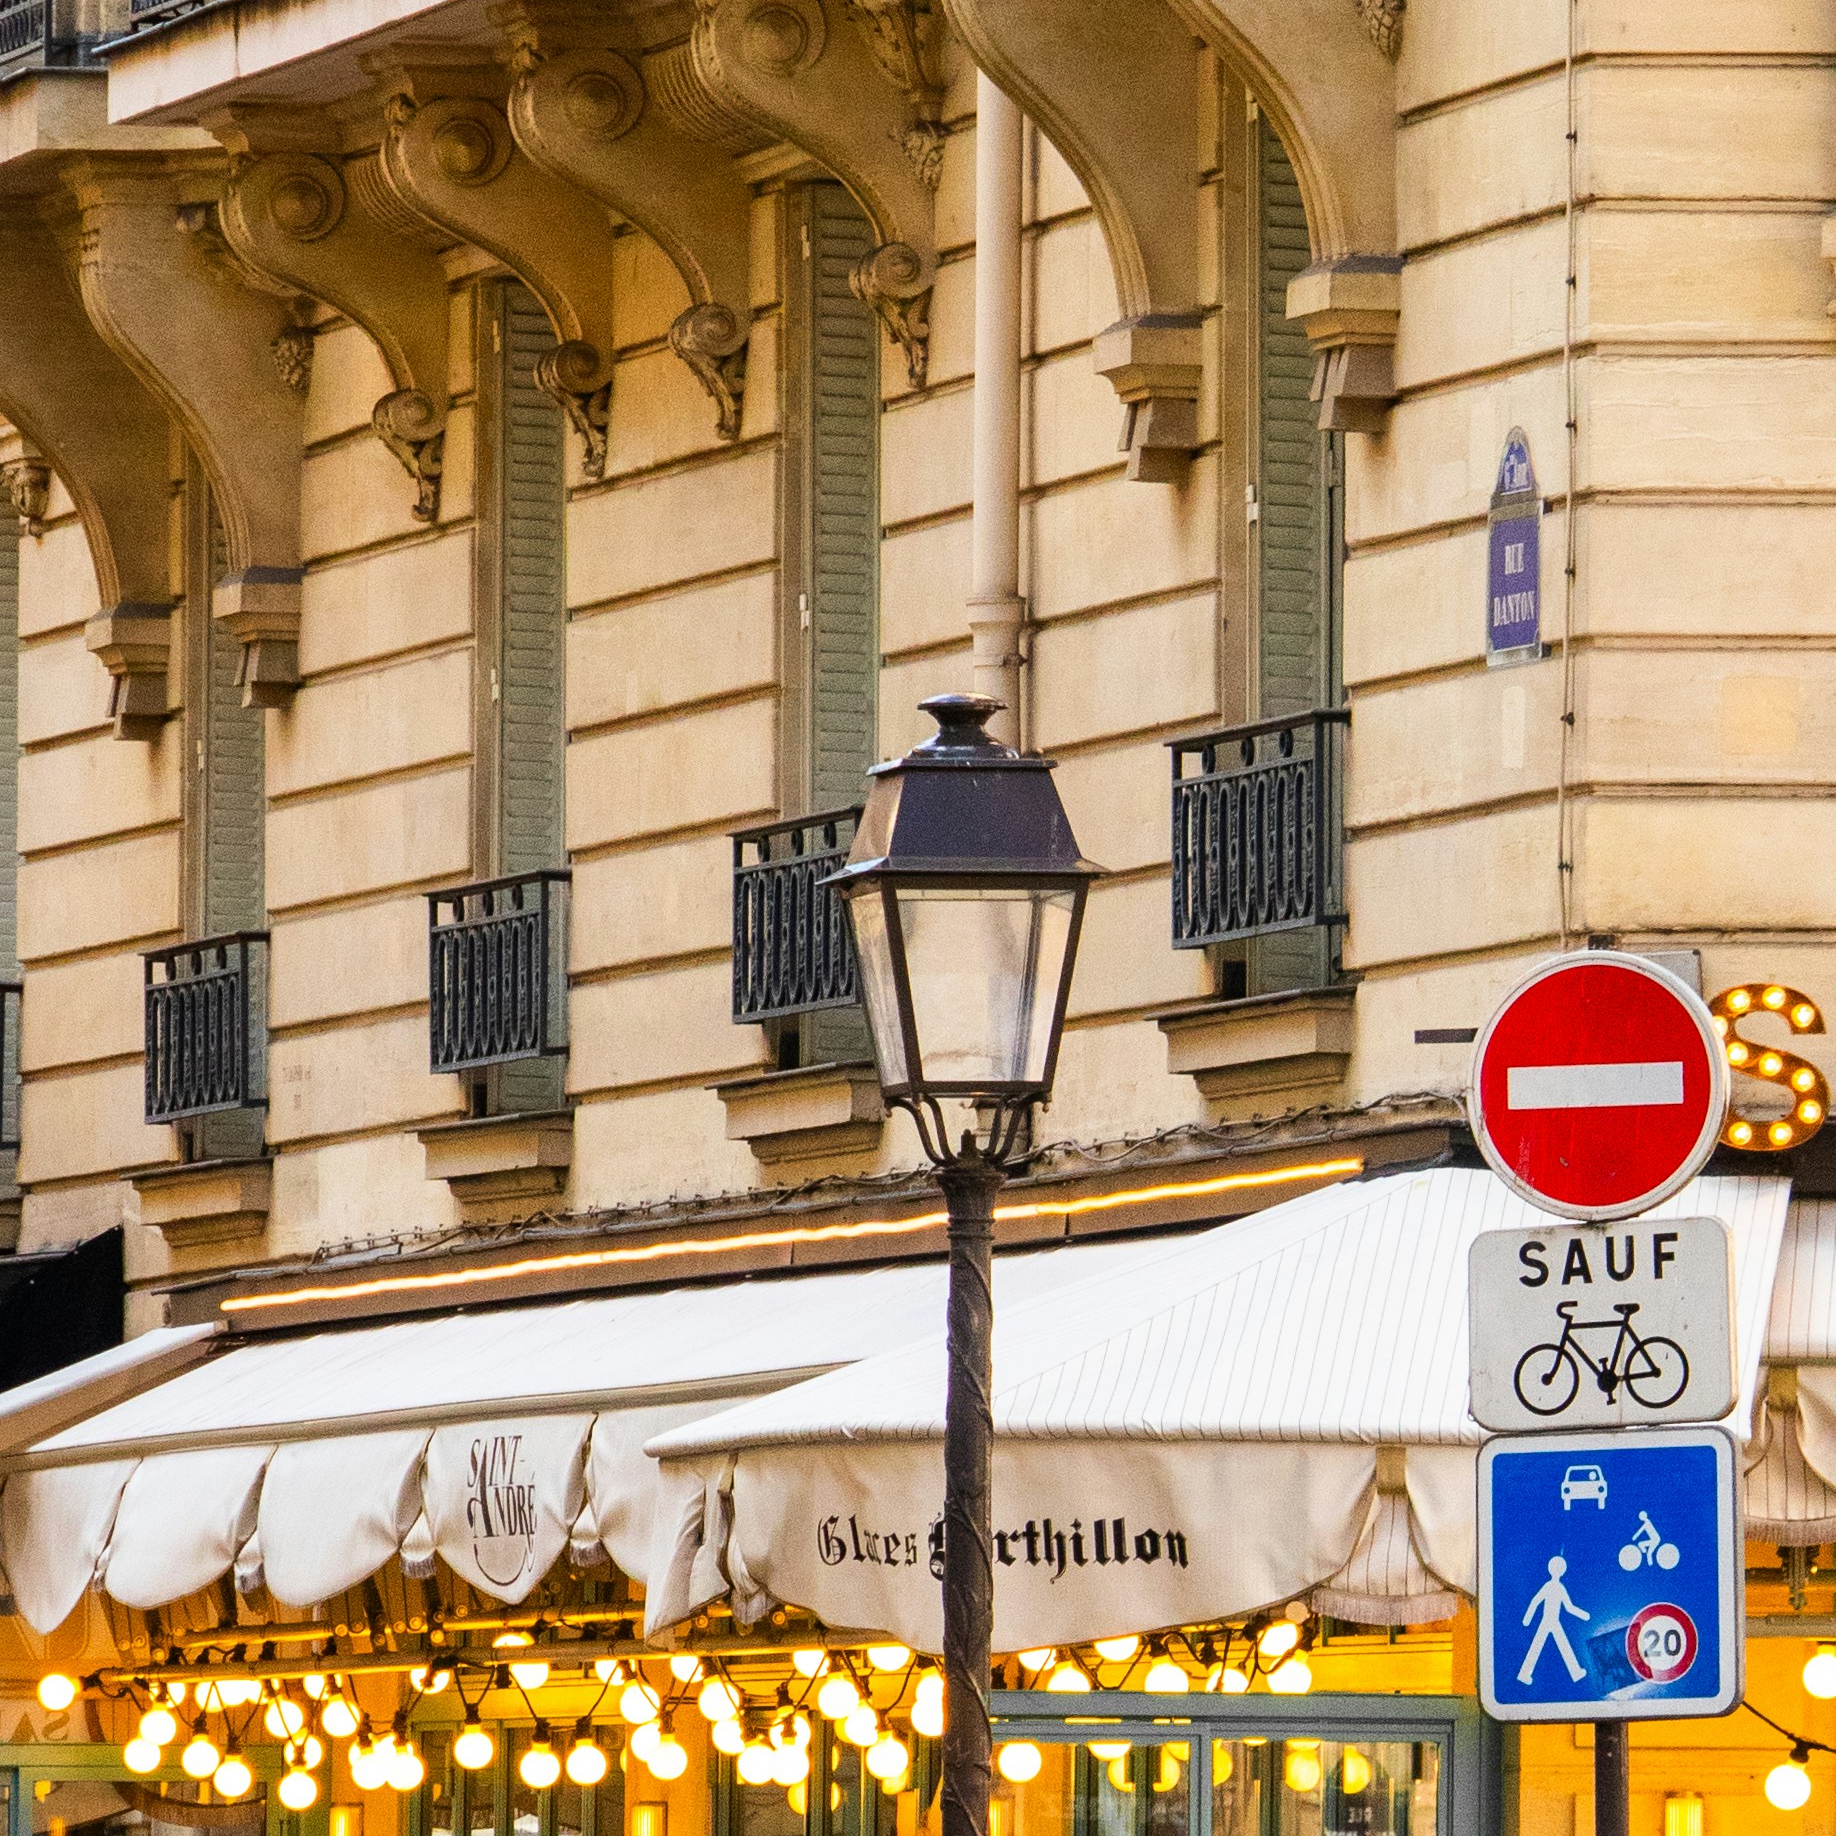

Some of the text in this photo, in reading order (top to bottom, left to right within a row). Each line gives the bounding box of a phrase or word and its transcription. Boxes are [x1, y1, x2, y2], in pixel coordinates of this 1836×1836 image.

[1505, 543, 1524, 574] RUE
[1493, 591, 1535, 628] DANTON
[1519, 1232, 1678, 1287] SAUF
[1643, 1629, 1681, 1657] 20
